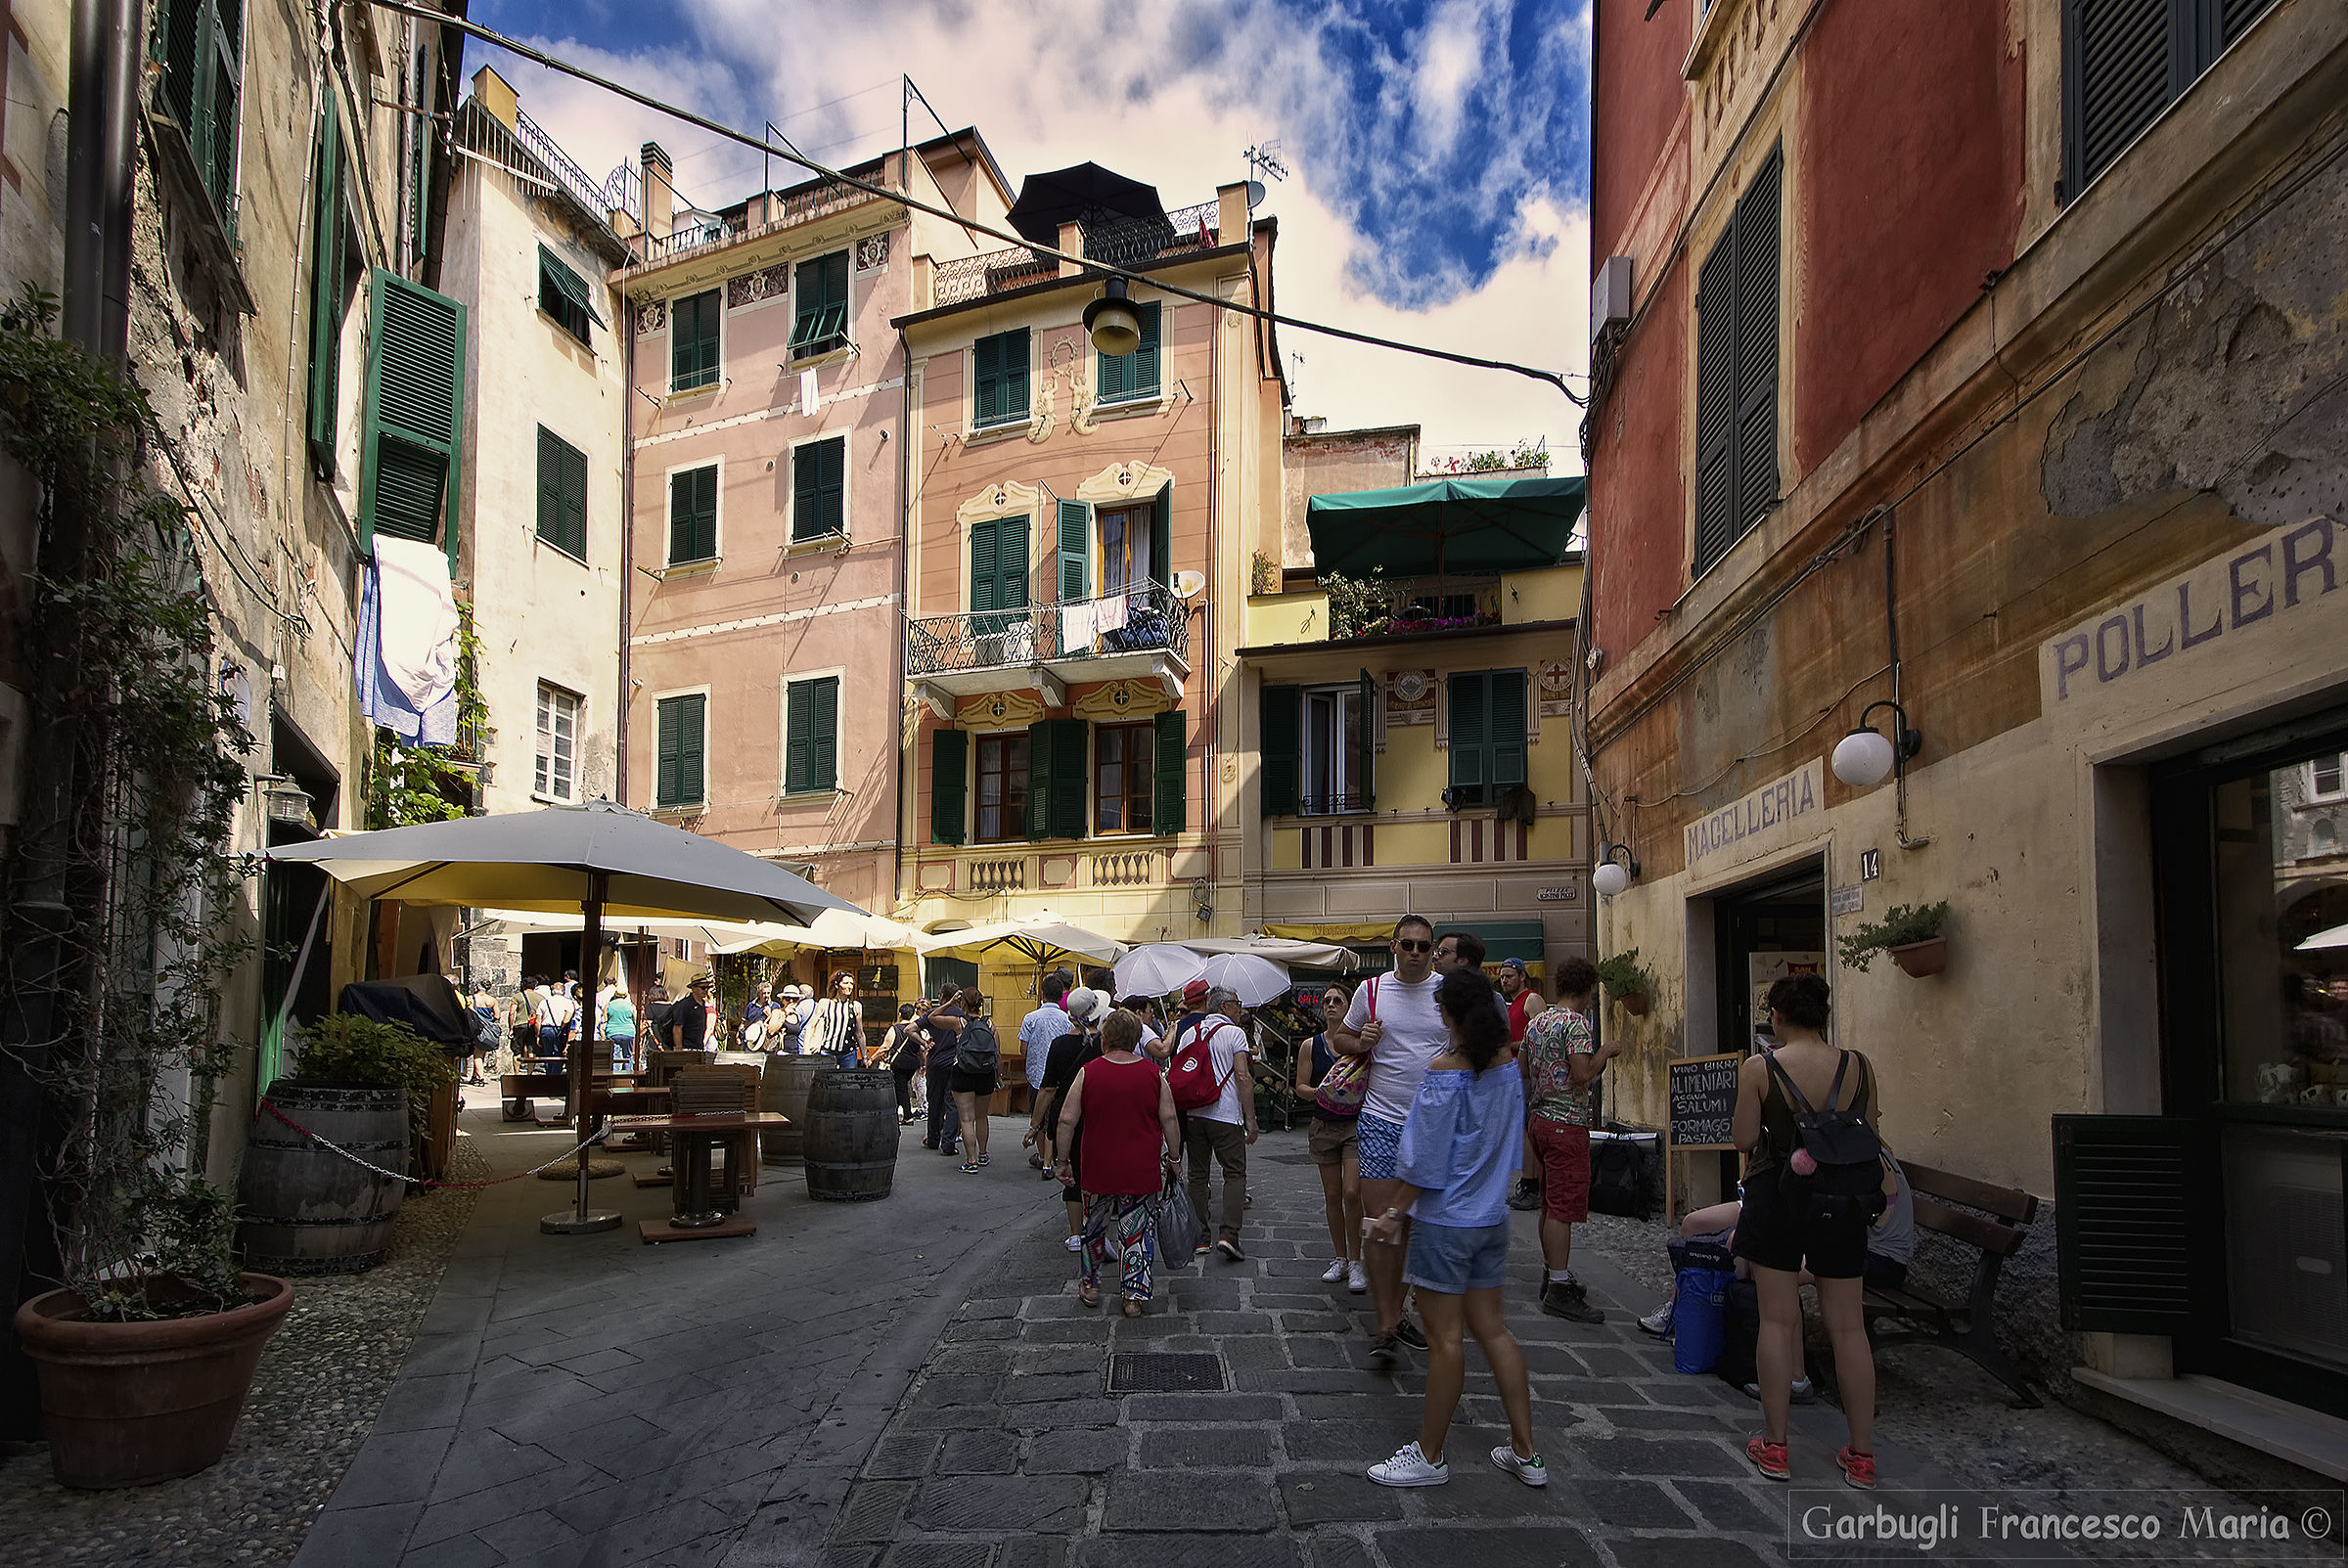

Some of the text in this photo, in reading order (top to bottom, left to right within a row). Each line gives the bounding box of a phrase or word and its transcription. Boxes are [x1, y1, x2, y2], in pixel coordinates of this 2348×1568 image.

[2053, 518, 2340, 700] POLLER
[1688, 770, 1815, 865] MACELLERIA
[1863, 851, 1878, 879] 14
[1297, 995, 1319, 1005] OPEN
[1673, 1059, 1738, 1074] VINO BIRRA
[1670, 1071, 1737, 1095] ALIMENTARI
[1672, 1093, 1707, 1102] ACQUA
[1676, 1098, 1727, 1114] SALUMI
[1678, 1133, 1716, 1144] PASTA
